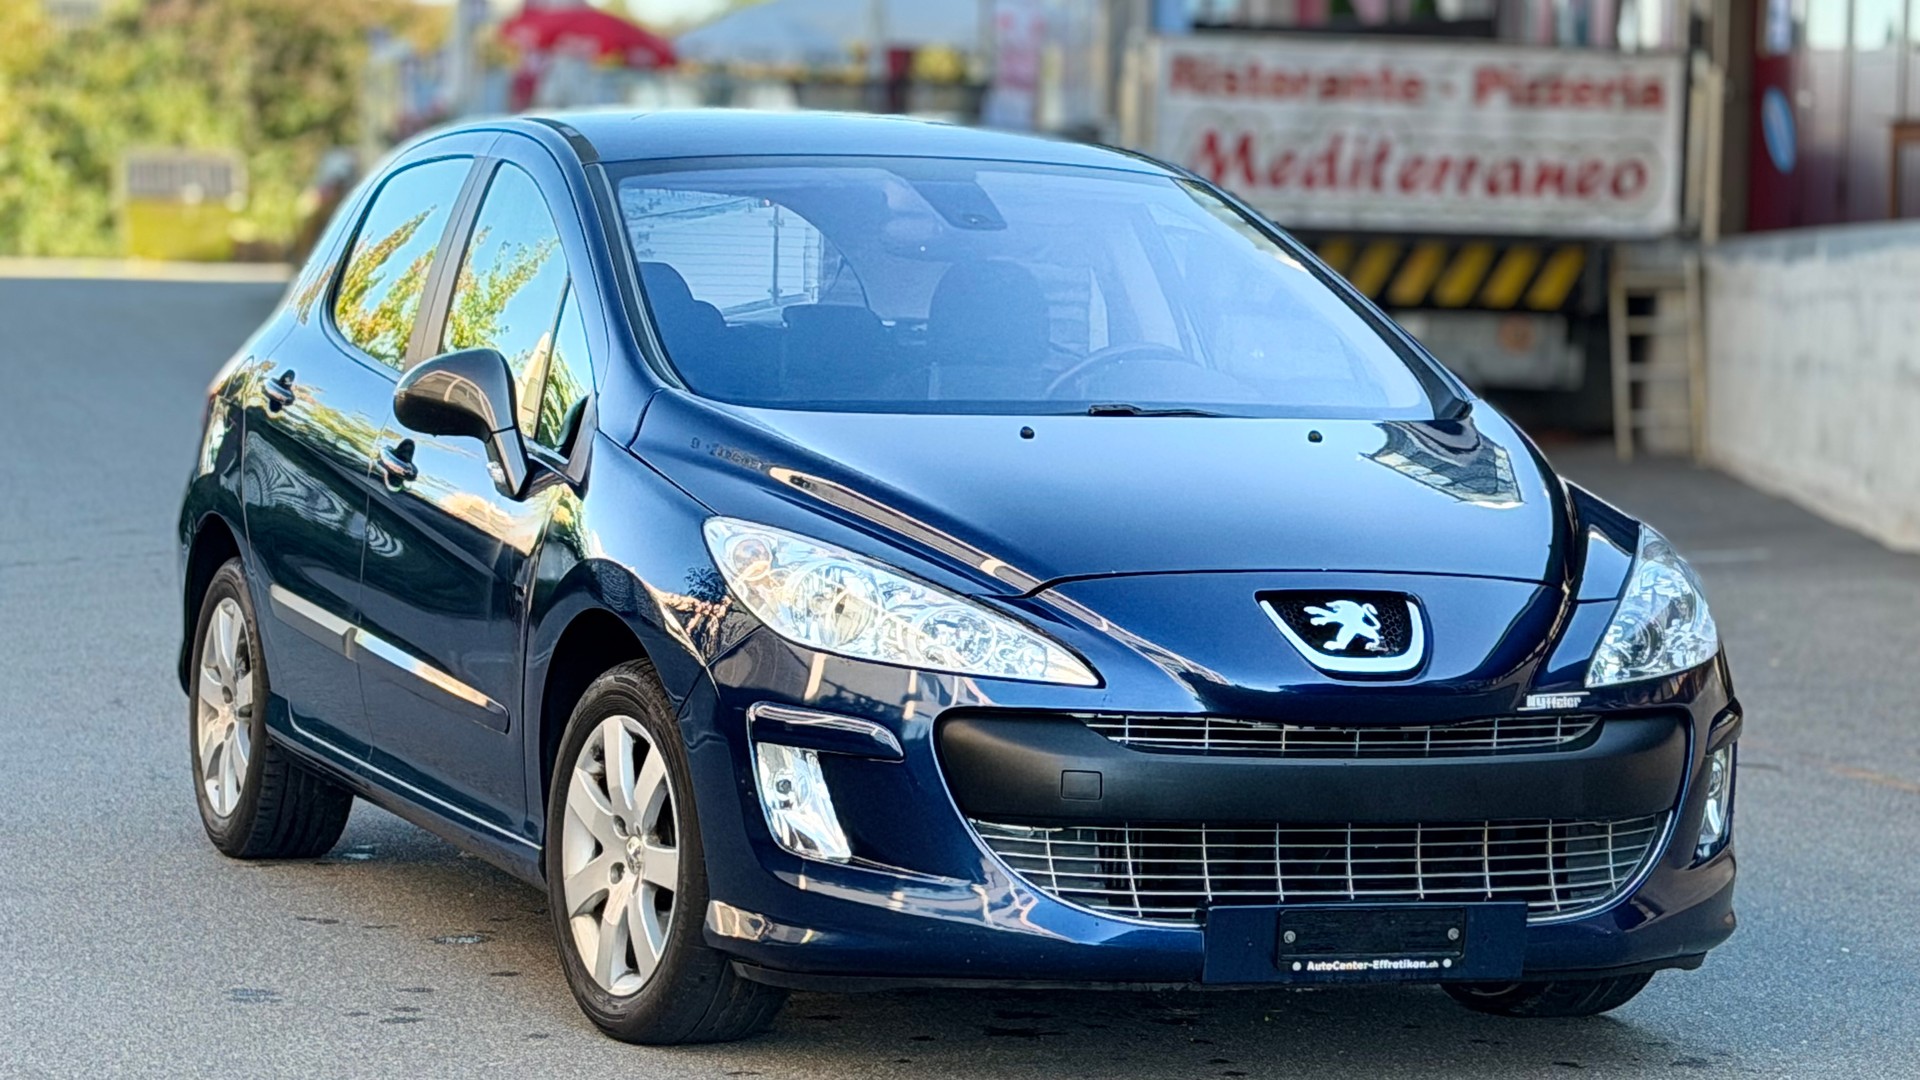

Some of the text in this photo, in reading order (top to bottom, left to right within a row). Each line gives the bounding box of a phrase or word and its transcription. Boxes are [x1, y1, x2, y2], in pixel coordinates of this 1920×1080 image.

[1171, 56, 1424, 102] Ristorante
[1473, 66, 1665, 111] Pizzeria
[1193, 131, 1649, 199] Mediterraneo
[1306, 958, 1440, 972] AutoCenter-Effretikon.ch
